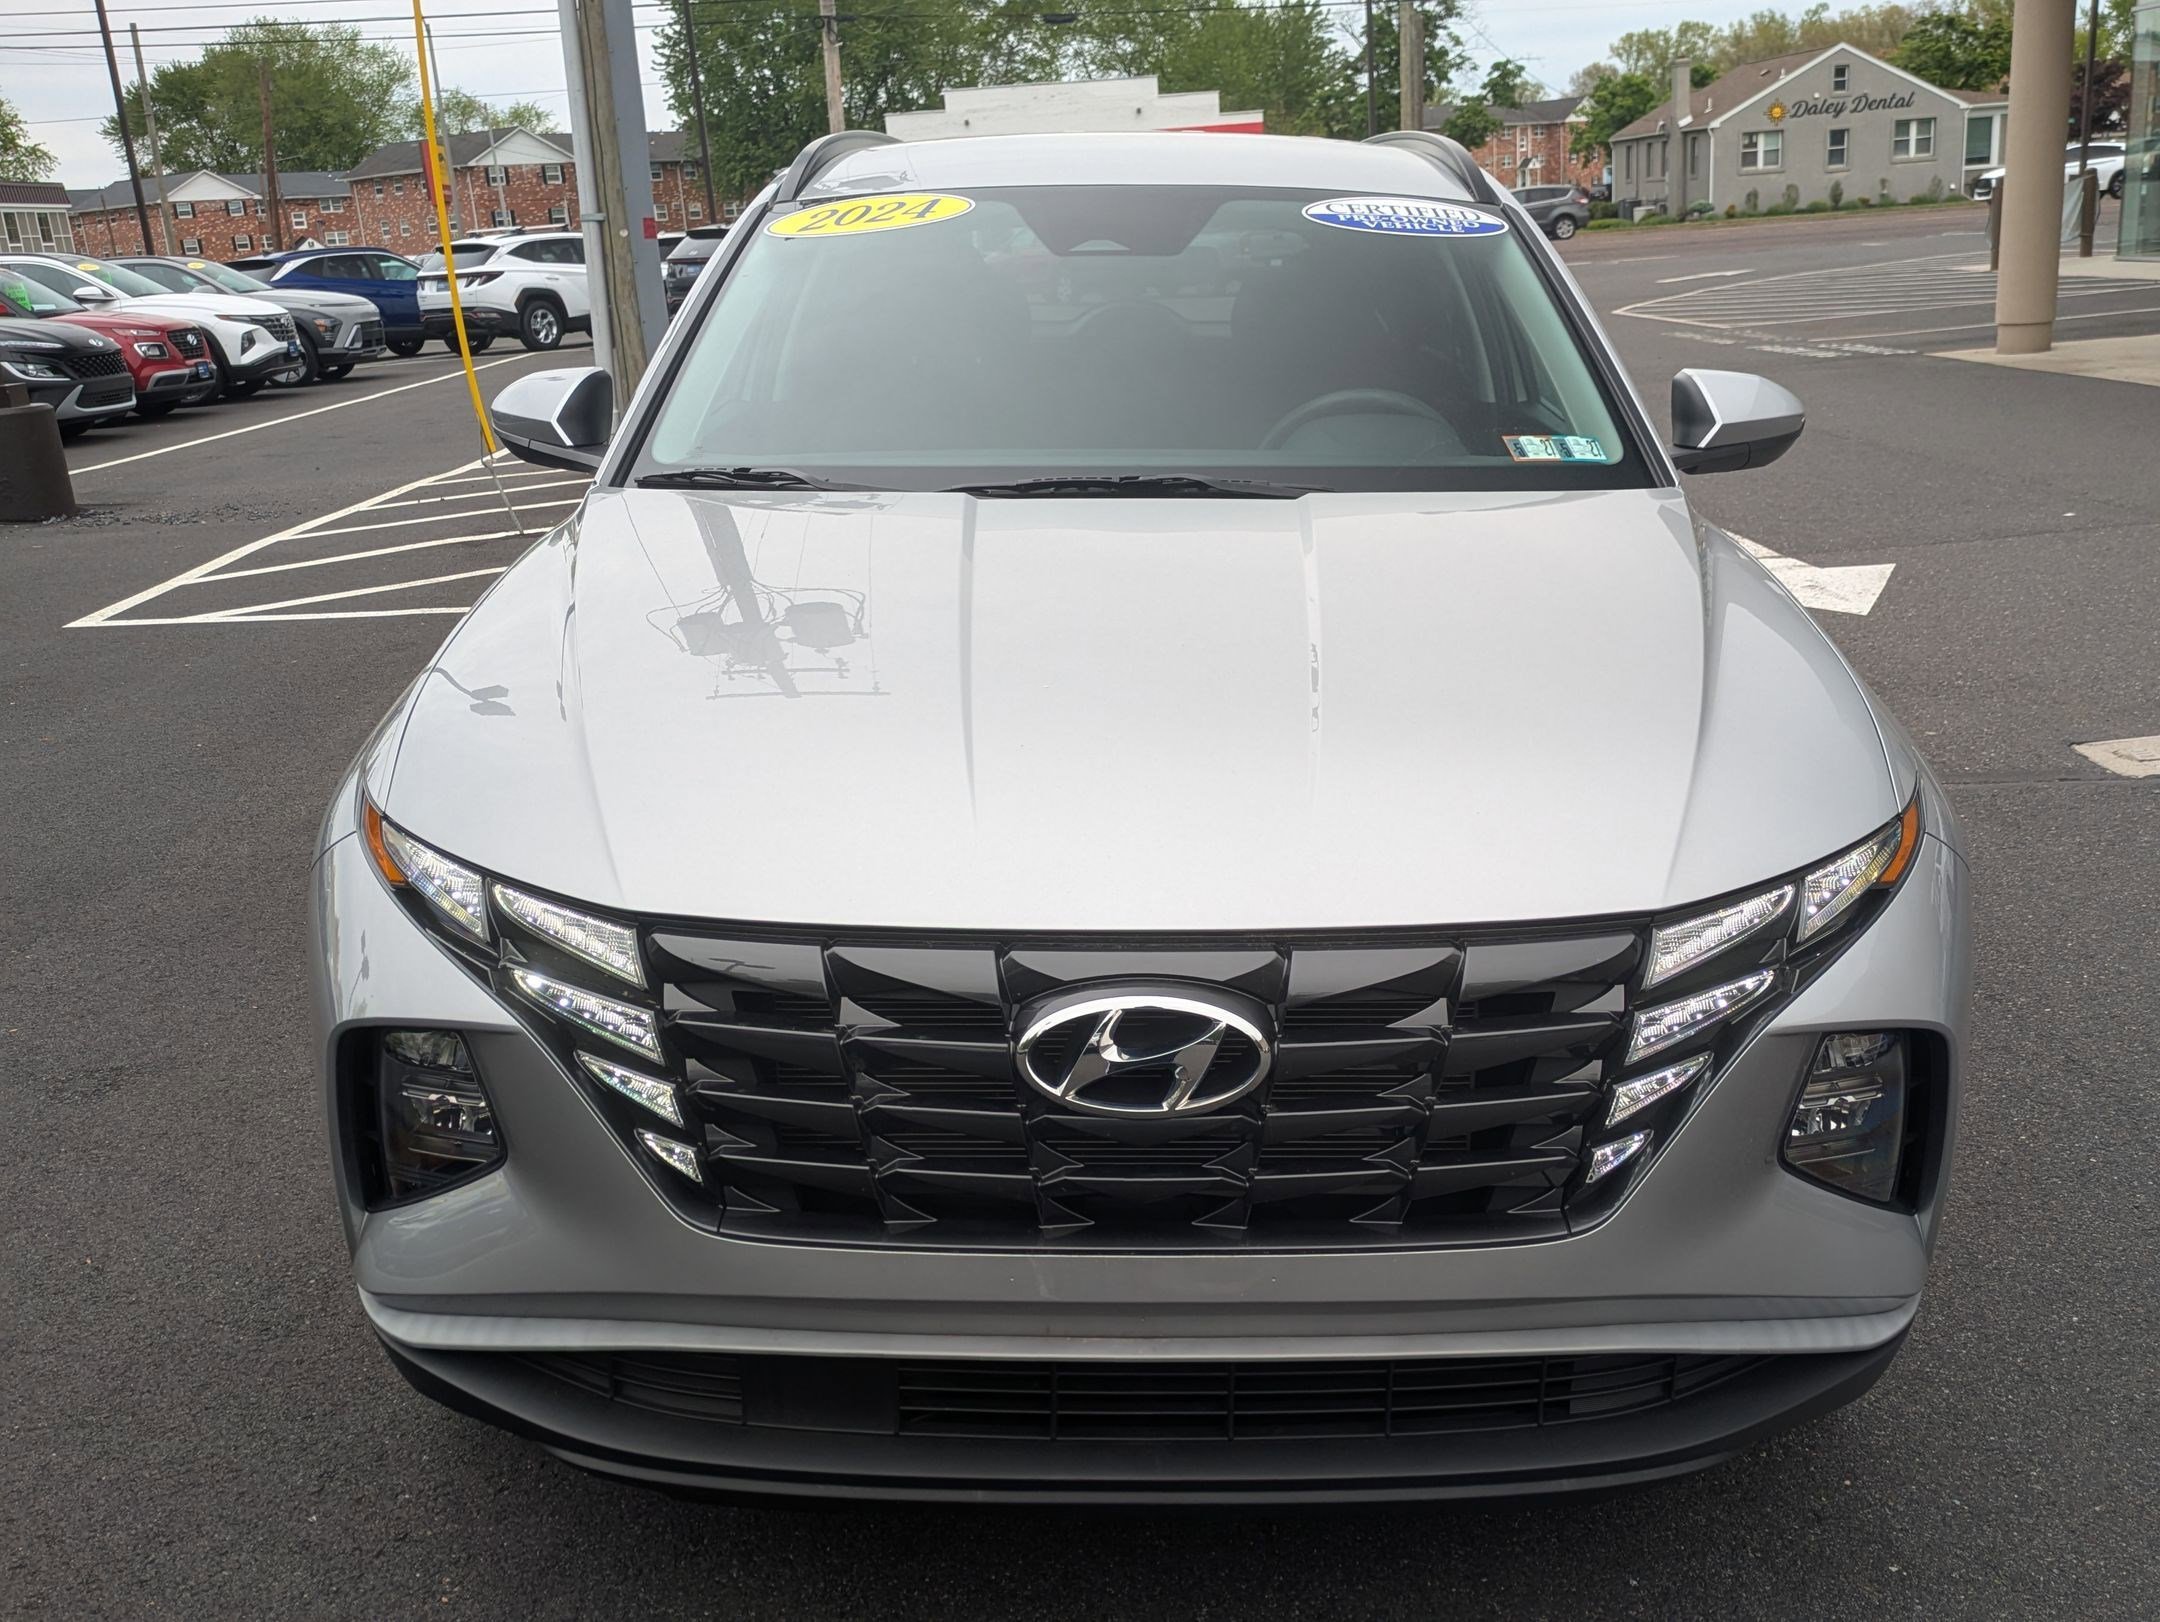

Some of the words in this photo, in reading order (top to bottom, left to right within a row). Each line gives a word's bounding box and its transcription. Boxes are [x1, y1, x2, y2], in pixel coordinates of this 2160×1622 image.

[1790, 99, 1847, 118] Daley
[1850, 91, 1915, 113] Dental
[797, 198, 941, 232] 2024
[1326, 203, 1480, 221] CERTIFIED
[1337, 214, 1480, 228] PRE-OWNED
[1362, 220, 1465, 233] VEHICLE
